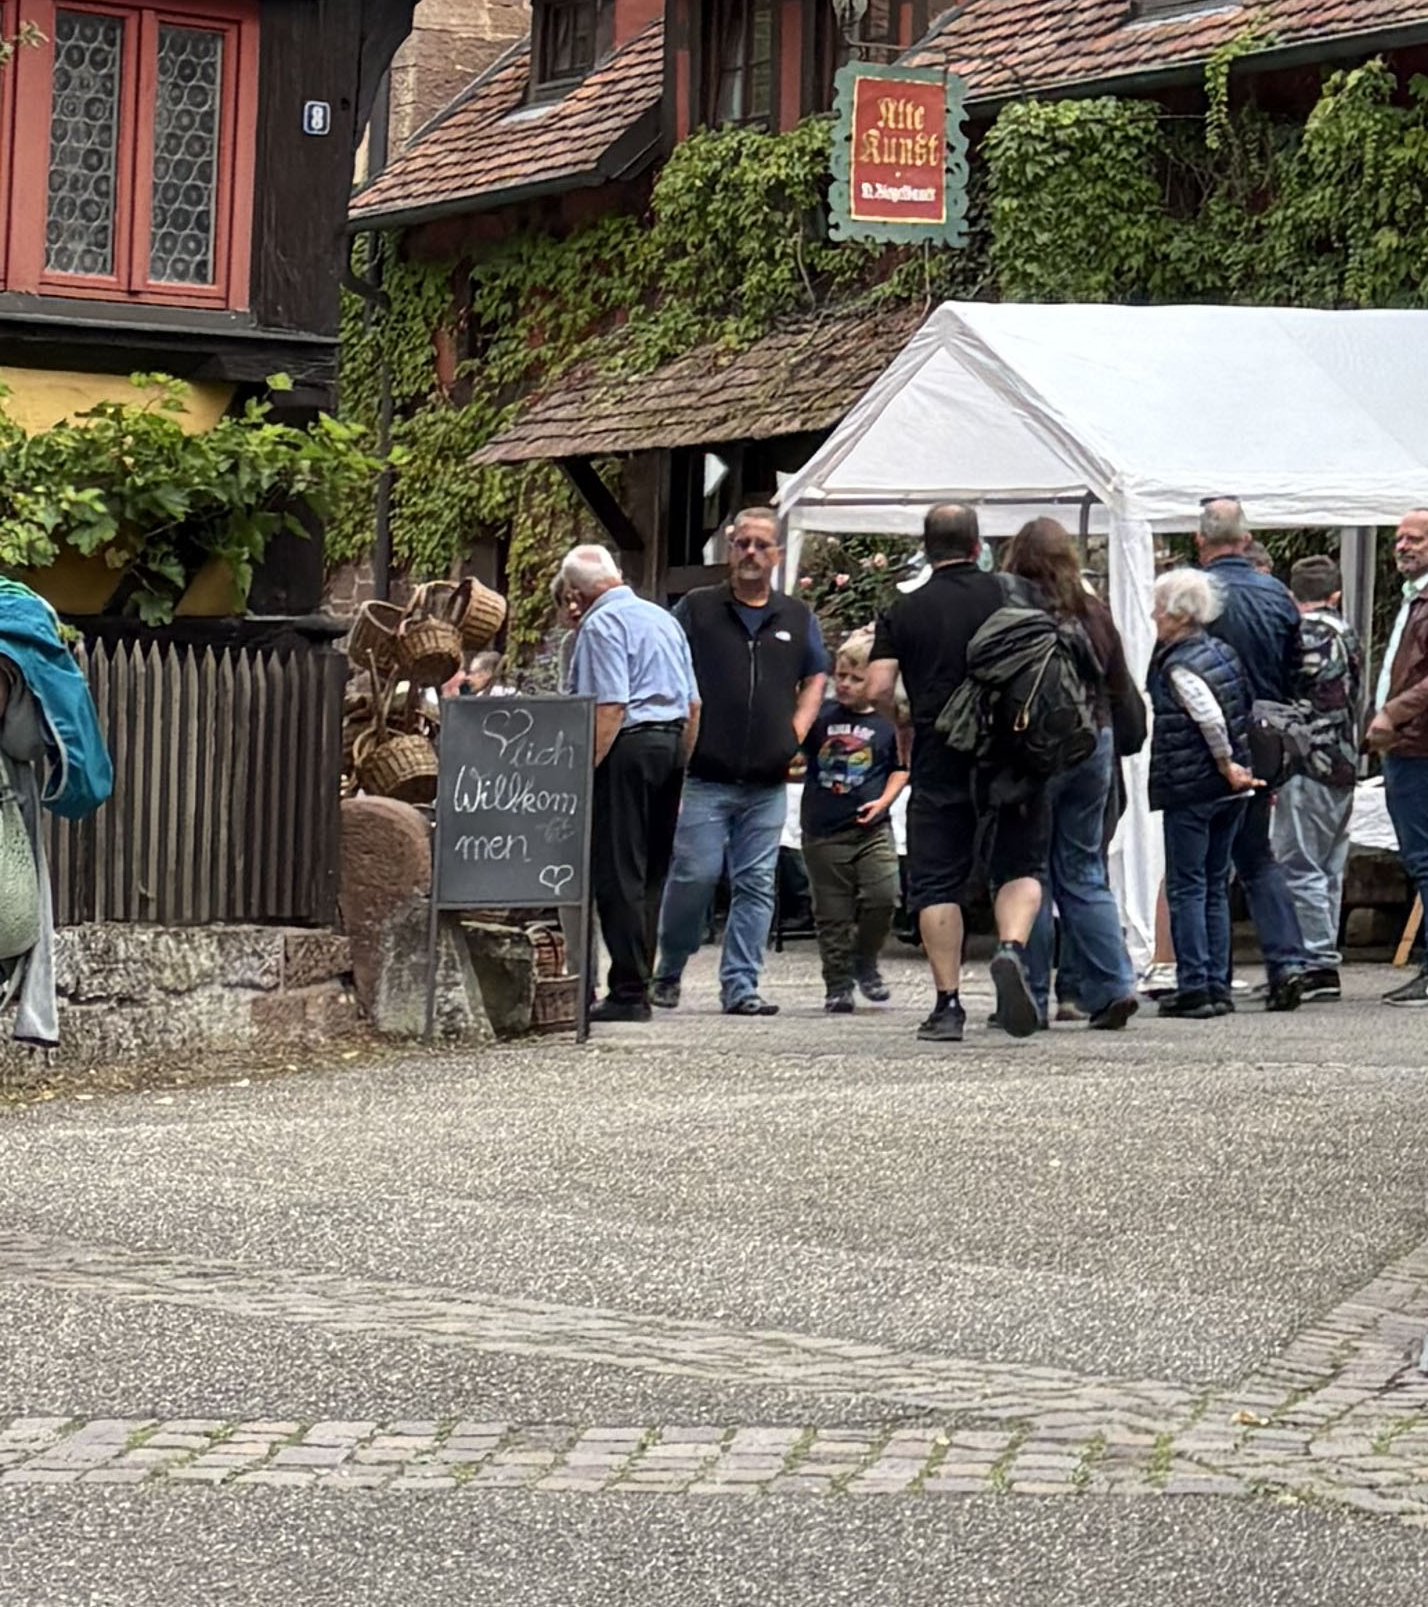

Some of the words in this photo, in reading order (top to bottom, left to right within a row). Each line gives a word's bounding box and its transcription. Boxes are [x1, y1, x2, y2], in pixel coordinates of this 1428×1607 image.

[310, 105, 324, 130] 8
[877, 97, 925, 130] Alte
[859, 129, 940, 167] Kunst
[509, 730, 575, 770] lich
[454, 764, 578, 815] Willkom
